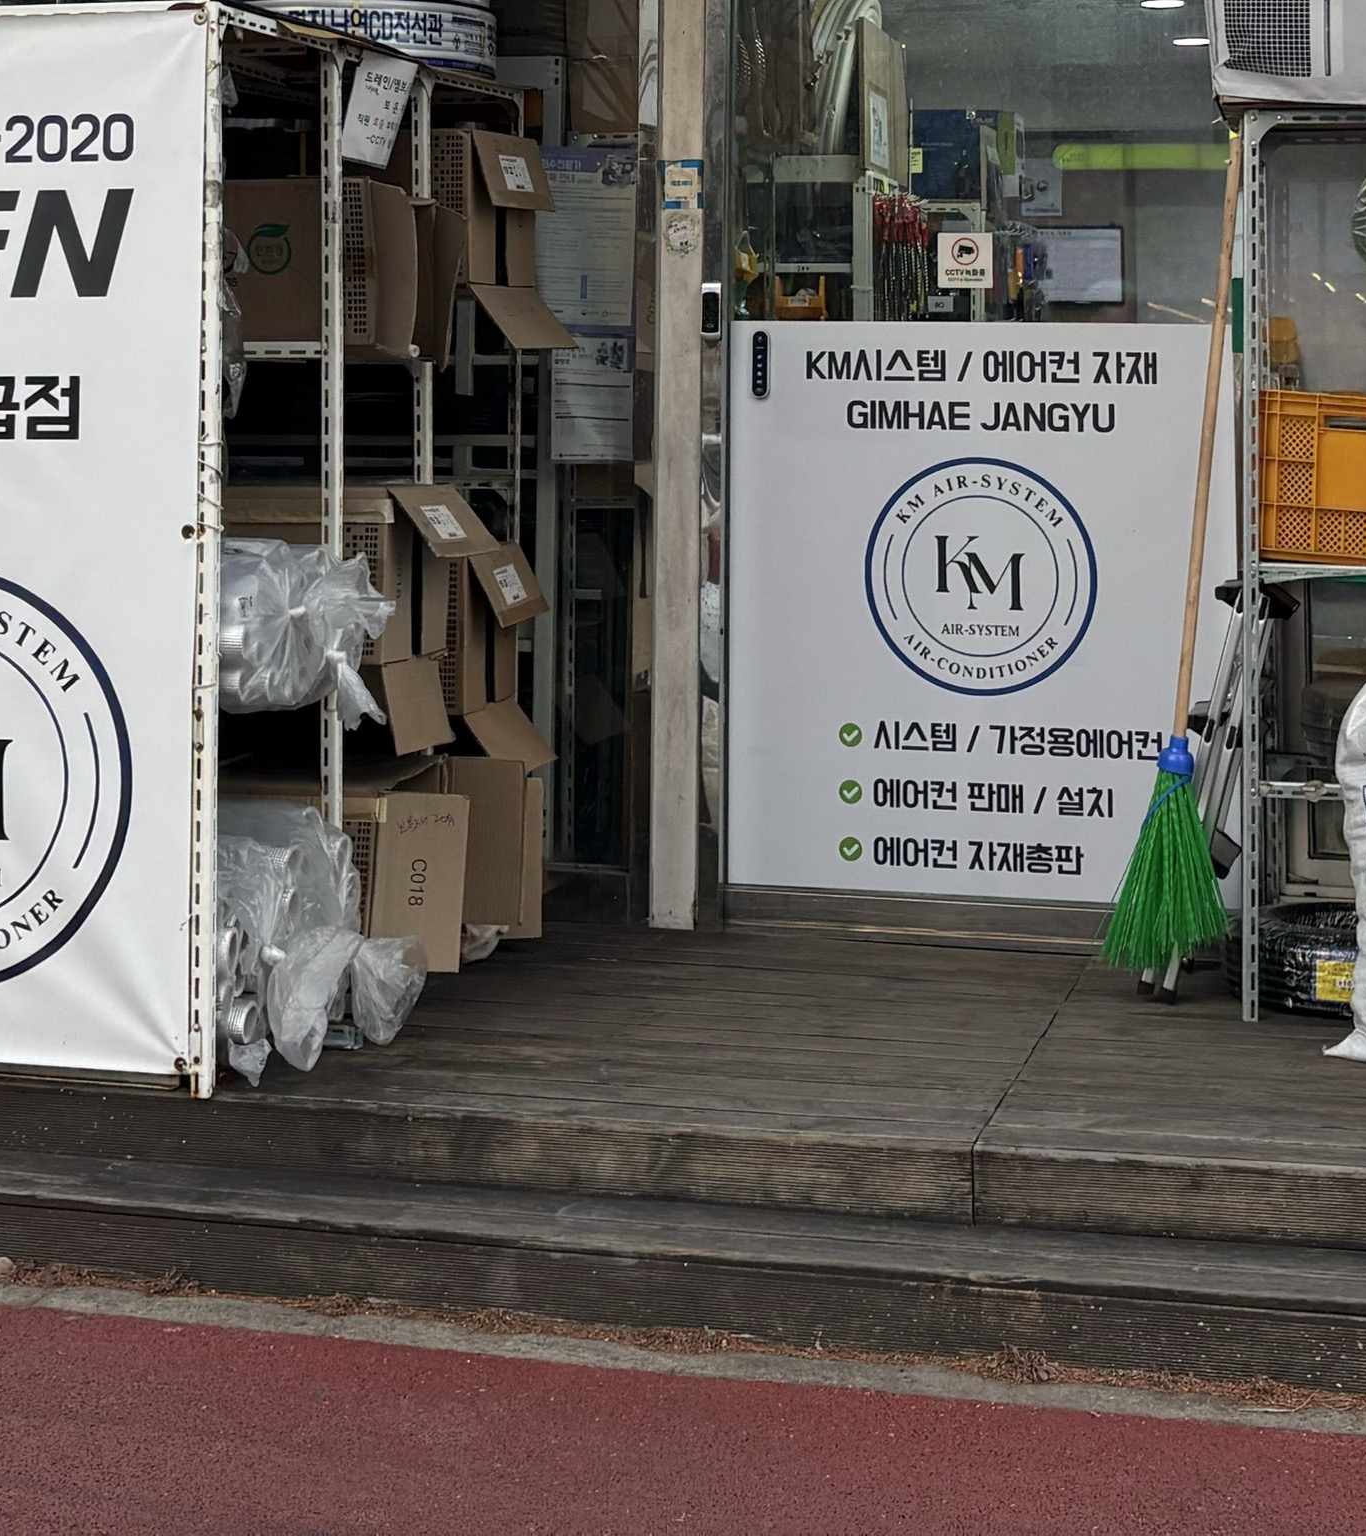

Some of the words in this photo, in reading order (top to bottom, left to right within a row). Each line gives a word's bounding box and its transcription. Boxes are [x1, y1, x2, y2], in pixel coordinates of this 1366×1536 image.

[805, 348, 946, 383] KM시스템
[981, 350, 1081, 384] 에어컨
[1092, 352, 1158, 385] 자재
[846, 400, 970, 431] GIMHAE
[980, 402, 1116, 434] JANGYU
[896, 492, 926, 525] KM
[932, 472, 1064, 529] AIR-SYSTEM
[934, 535, 1025, 611] KM
[941, 623, 1020, 638] AIR-SYSTEM
[903, 633, 1060, 680] AIR-CONDITIONER
[873, 721, 957, 753] 시스템
[989, 724, 1164, 761] 가정용에어컨
[873, 779, 957, 812] 에어컨
[967, 782, 1024, 815] 판매
[1056, 785, 1114, 818] 설치
[873, 836, 957, 870] 에어컨
[968, 840, 1084, 876] 자재총판
[408, 859, 428, 906] C018
